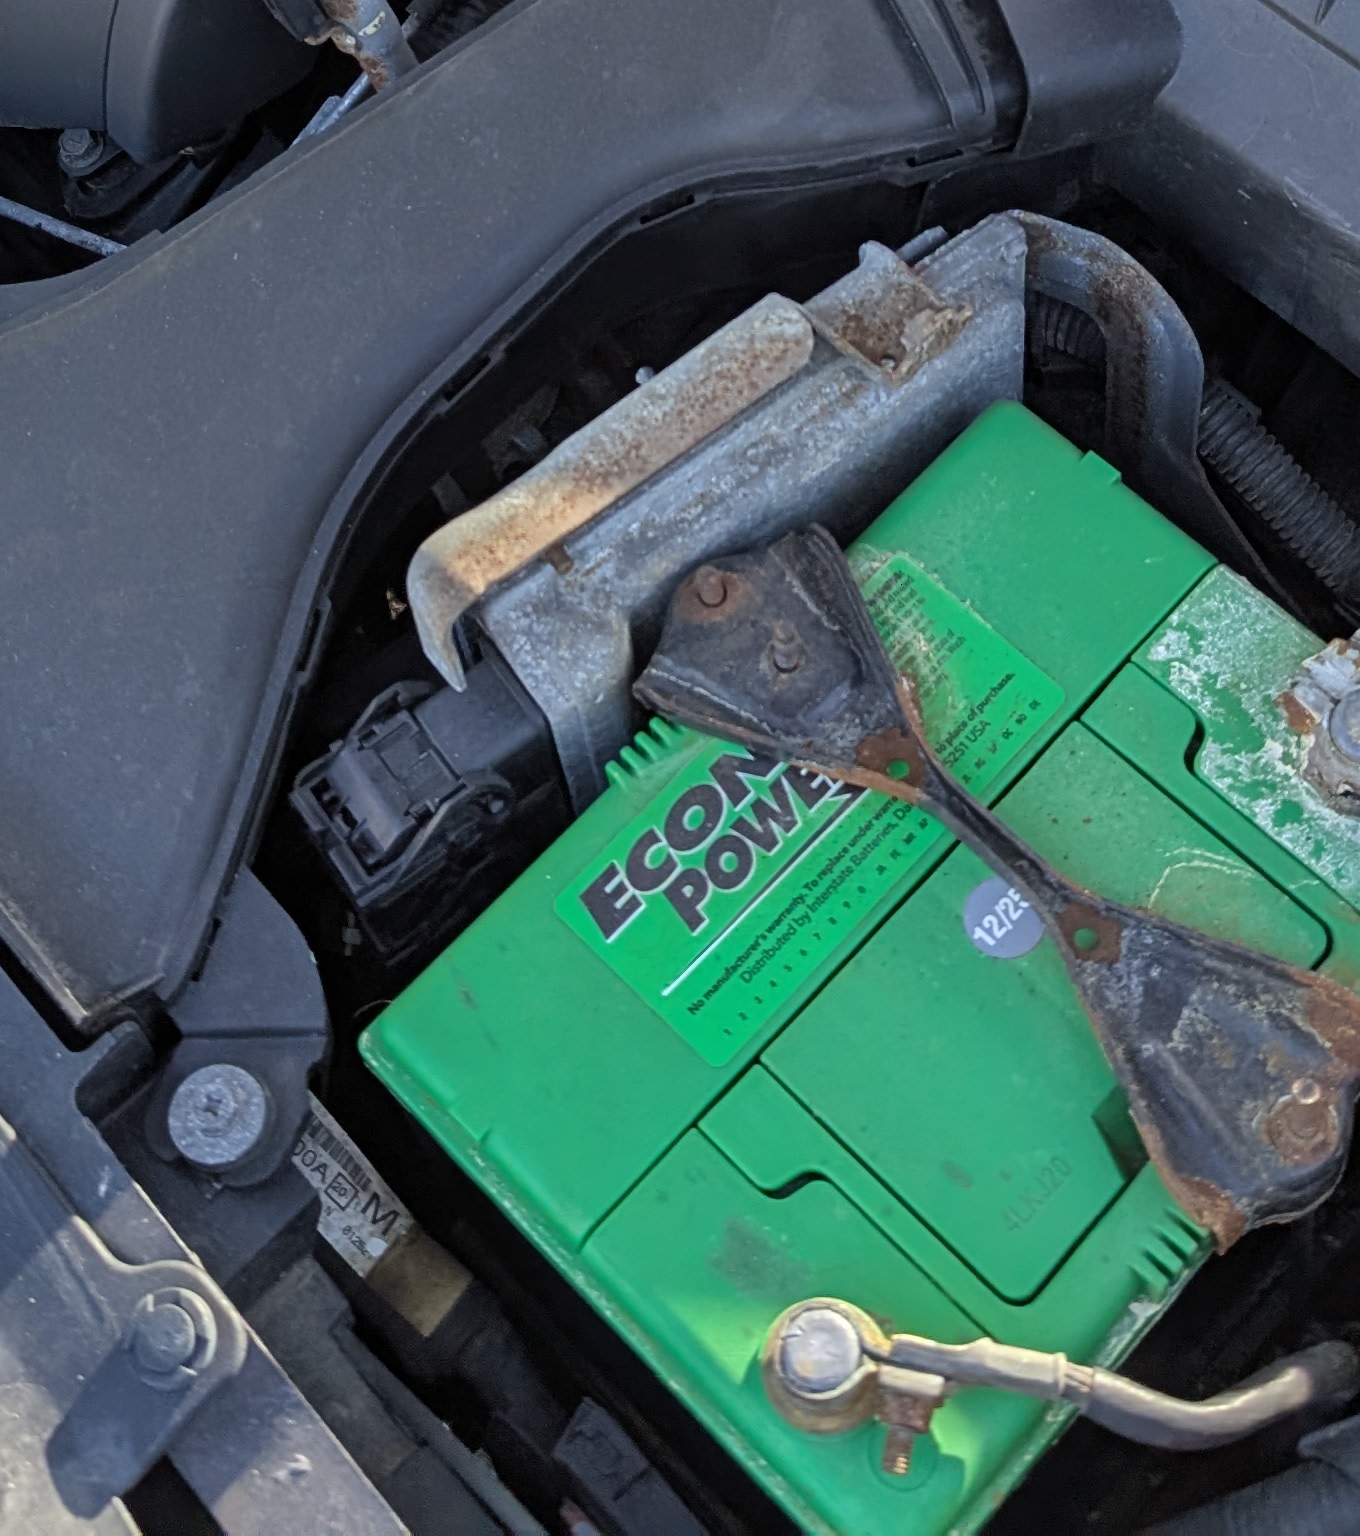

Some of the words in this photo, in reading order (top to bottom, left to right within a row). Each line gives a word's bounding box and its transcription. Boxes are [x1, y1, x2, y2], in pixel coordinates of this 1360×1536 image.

[579, 752, 783, 944] ECON
[662, 763, 860, 936] POWE
[685, 995, 706, 1017] No
[699, 929, 769, 1001] manufacturer's
[801, 875, 821, 894] To
[812, 842, 852, 883] replace
[843, 816, 875, 849] under
[871, 793, 900, 822] warra
[931, 739, 947, 755] to
[942, 717, 971, 747] place
[963, 706, 979, 723] of
[737, 921, 800, 985] Distributed
[790, 906, 815, 931] by
[805, 861, 856, 914] Interstate
[848, 816, 900, 868] Batteries,
[940, 739, 970, 770] 5251
[963, 716, 992, 745] USA
[360, 1192, 402, 1237] M
[1000, 1155, 1073, 1233] 4LKJ20
